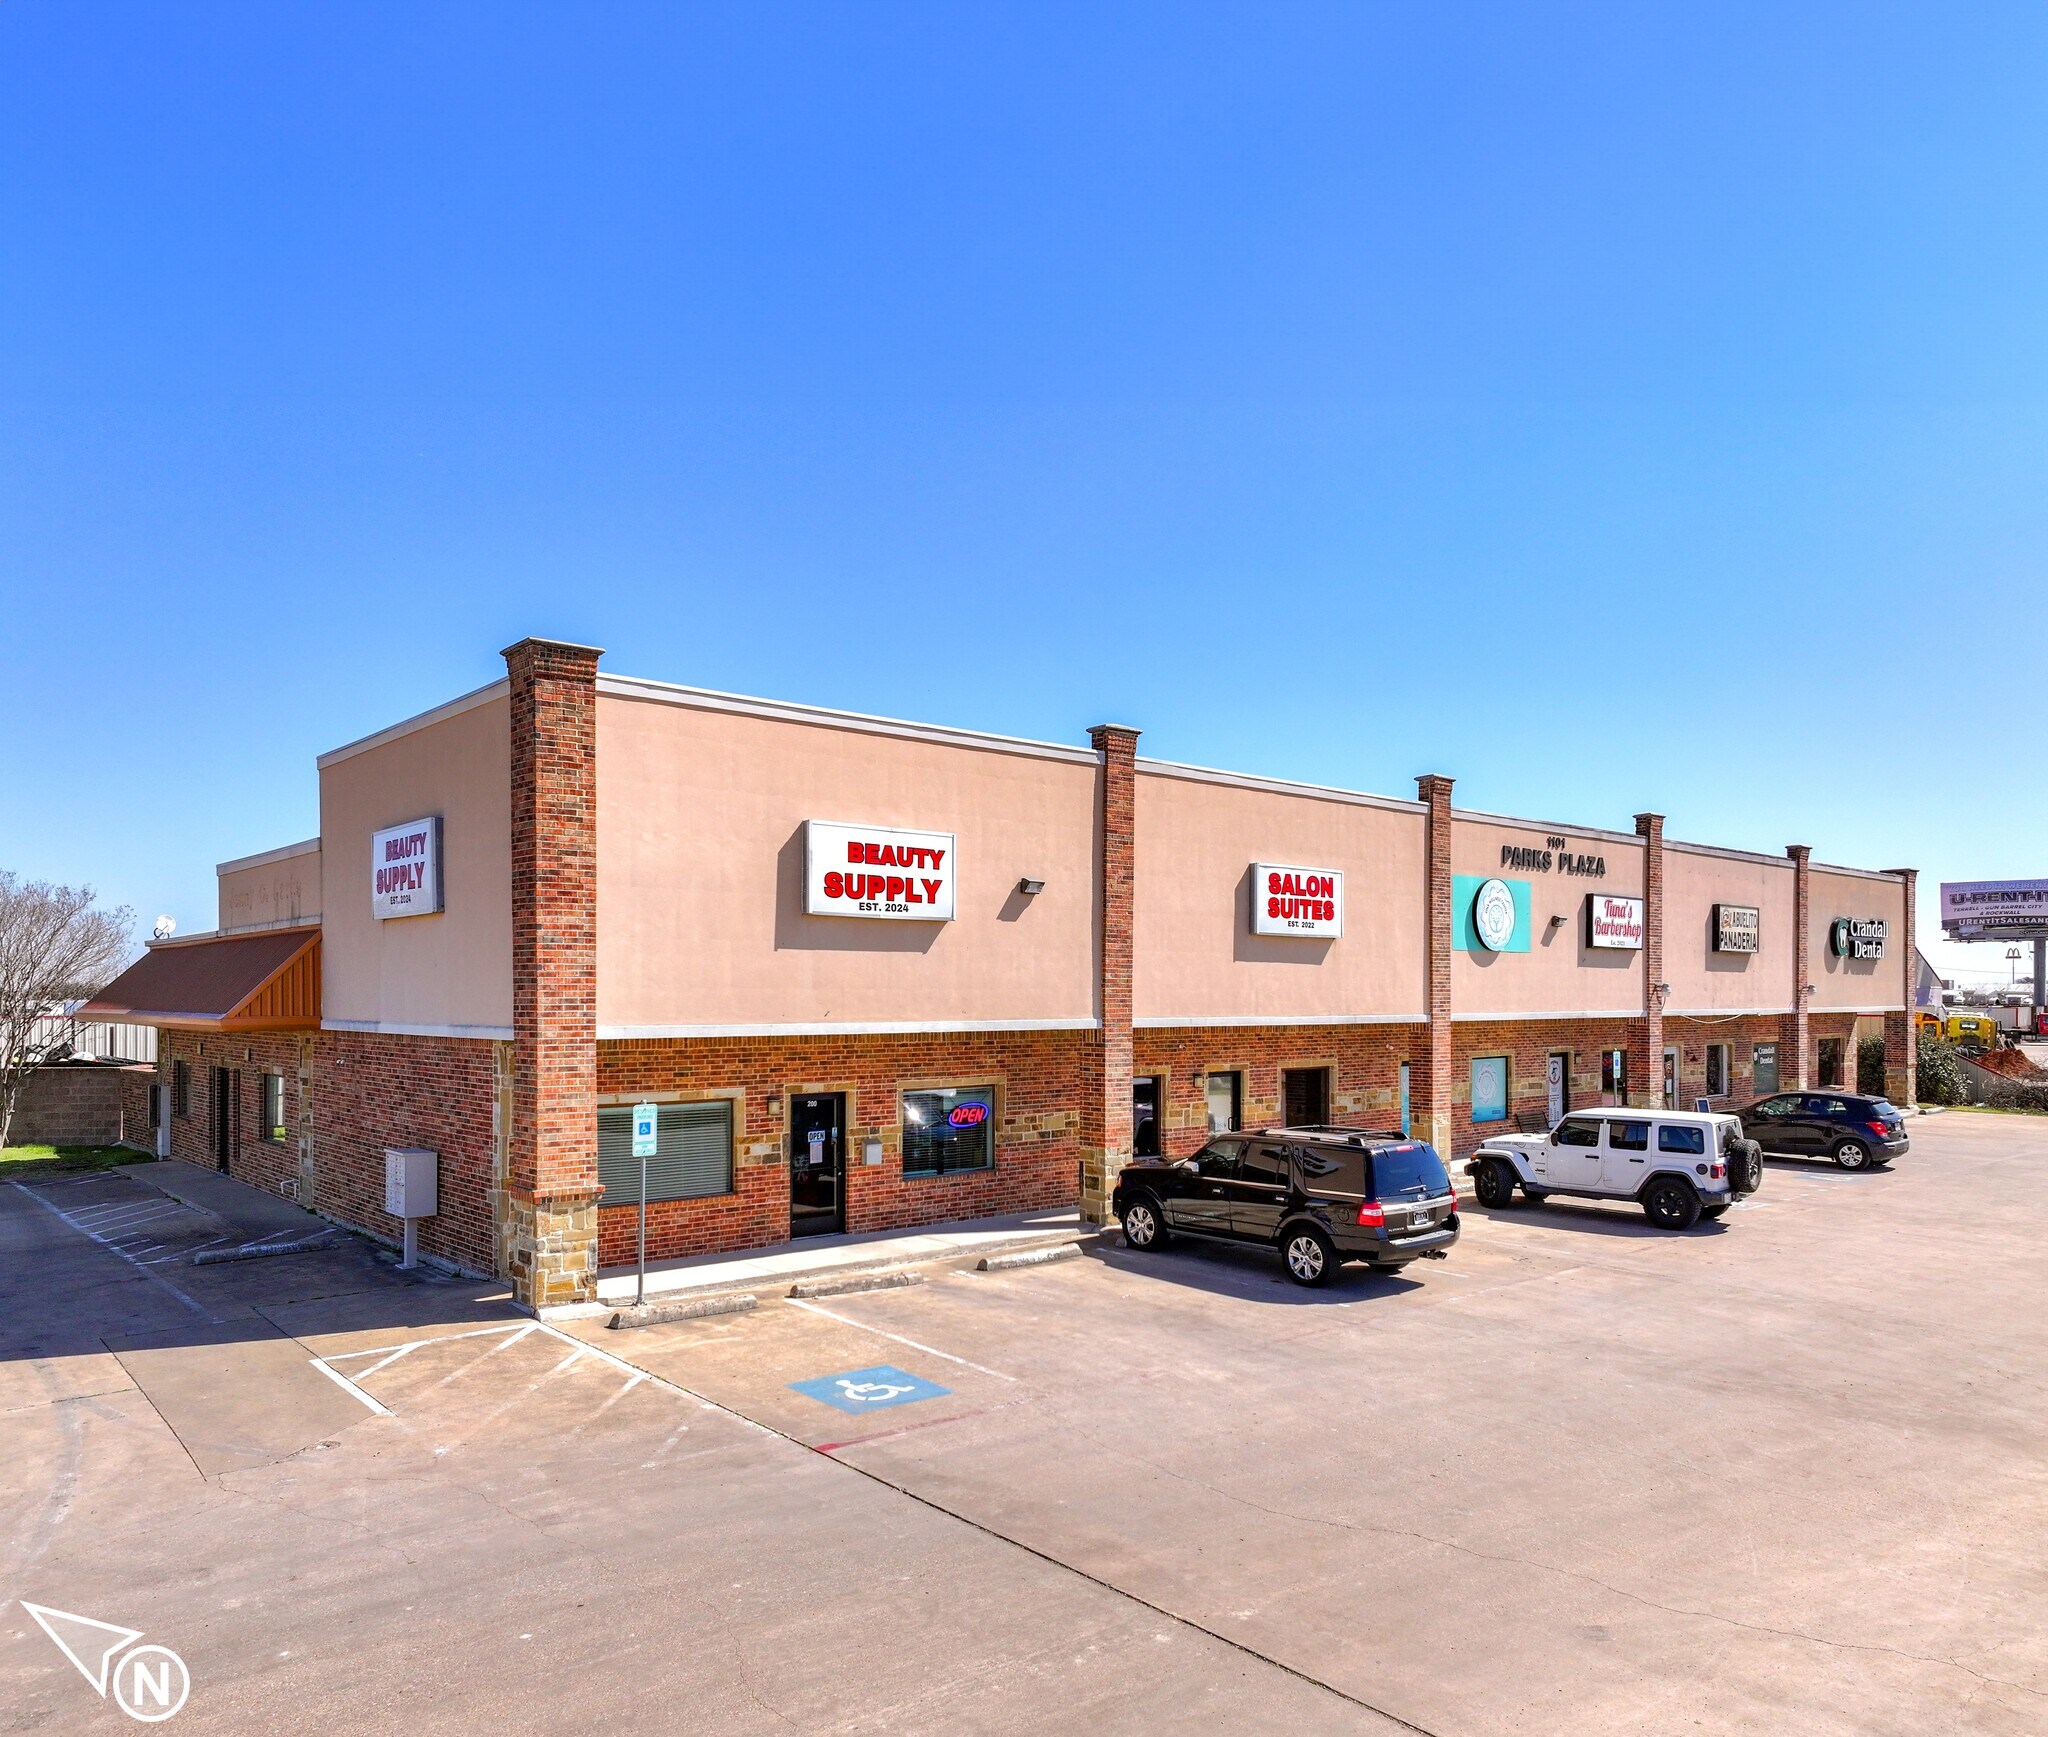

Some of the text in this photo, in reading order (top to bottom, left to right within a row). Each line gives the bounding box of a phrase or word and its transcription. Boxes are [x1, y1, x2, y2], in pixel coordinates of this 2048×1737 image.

[385, 832, 428, 862] BEAUTY
[1546, 835, 1566, 849] 1101
[847, 841, 946, 870] BEAUTY
[1501, 845, 1606, 875] PARKS PLAZA
[376, 861, 426, 894] SUPPLY
[824, 871, 943, 904] SUPPLY
[1268, 872, 1334, 899] SALON
[858, 902, 909, 912] EST. 2024
[1267, 897, 1335, 921] SUITES
[1604, 899, 1633, 919] Tuna's
[1287, 920, 1315, 929] EST. 2022
[1595, 916, 1642, 943] Barbershop
[1732, 911, 1757, 929] ABUELITO
[1850, 919, 1889, 938] Crandall
[1720, 930, 1757, 950] PANADERIA
[1854, 940, 1885, 959] Dental
[952, 1108, 984, 1123] OPEN
[809, 1131, 825, 1140] OPEN
